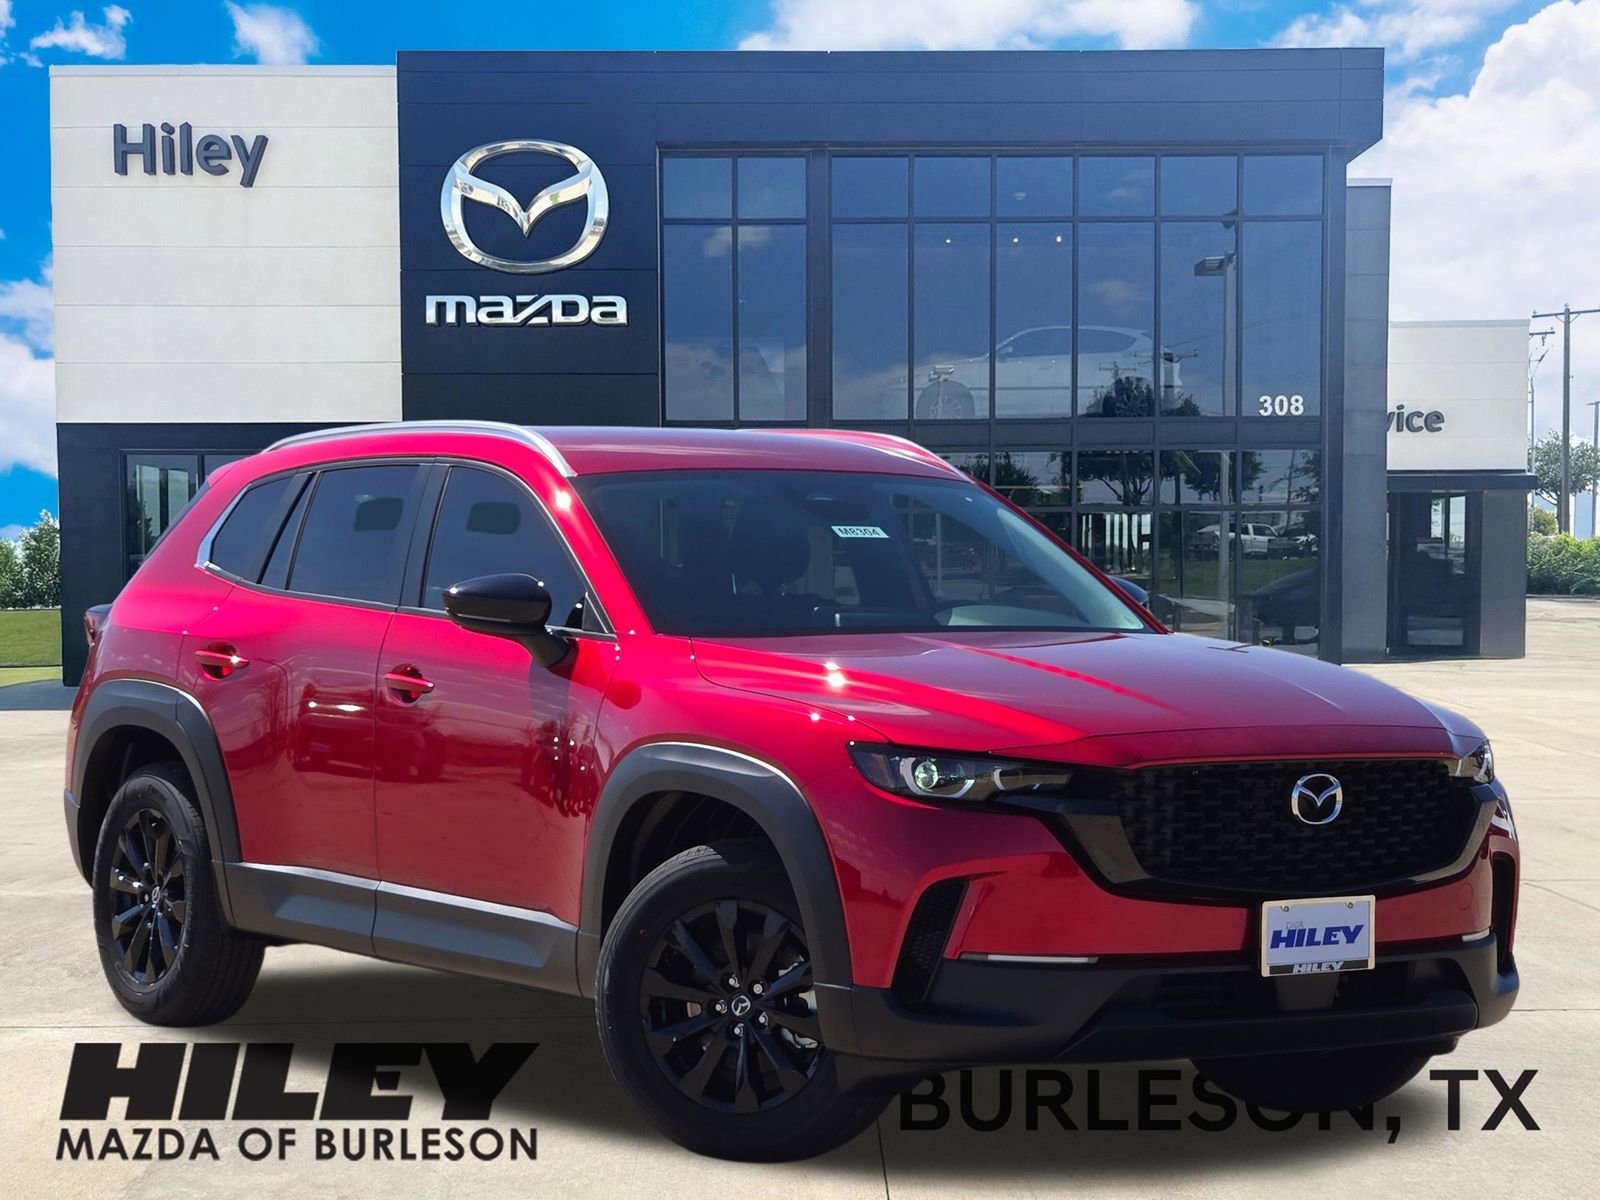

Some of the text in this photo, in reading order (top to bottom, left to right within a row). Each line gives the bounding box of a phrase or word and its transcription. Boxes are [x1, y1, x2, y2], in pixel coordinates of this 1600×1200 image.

[113, 121, 269, 188] Hiley
[1259, 395, 1304, 416] 308
[1270, 924, 1364, 949] HILEY
[1293, 961, 1344, 974] HILEY
